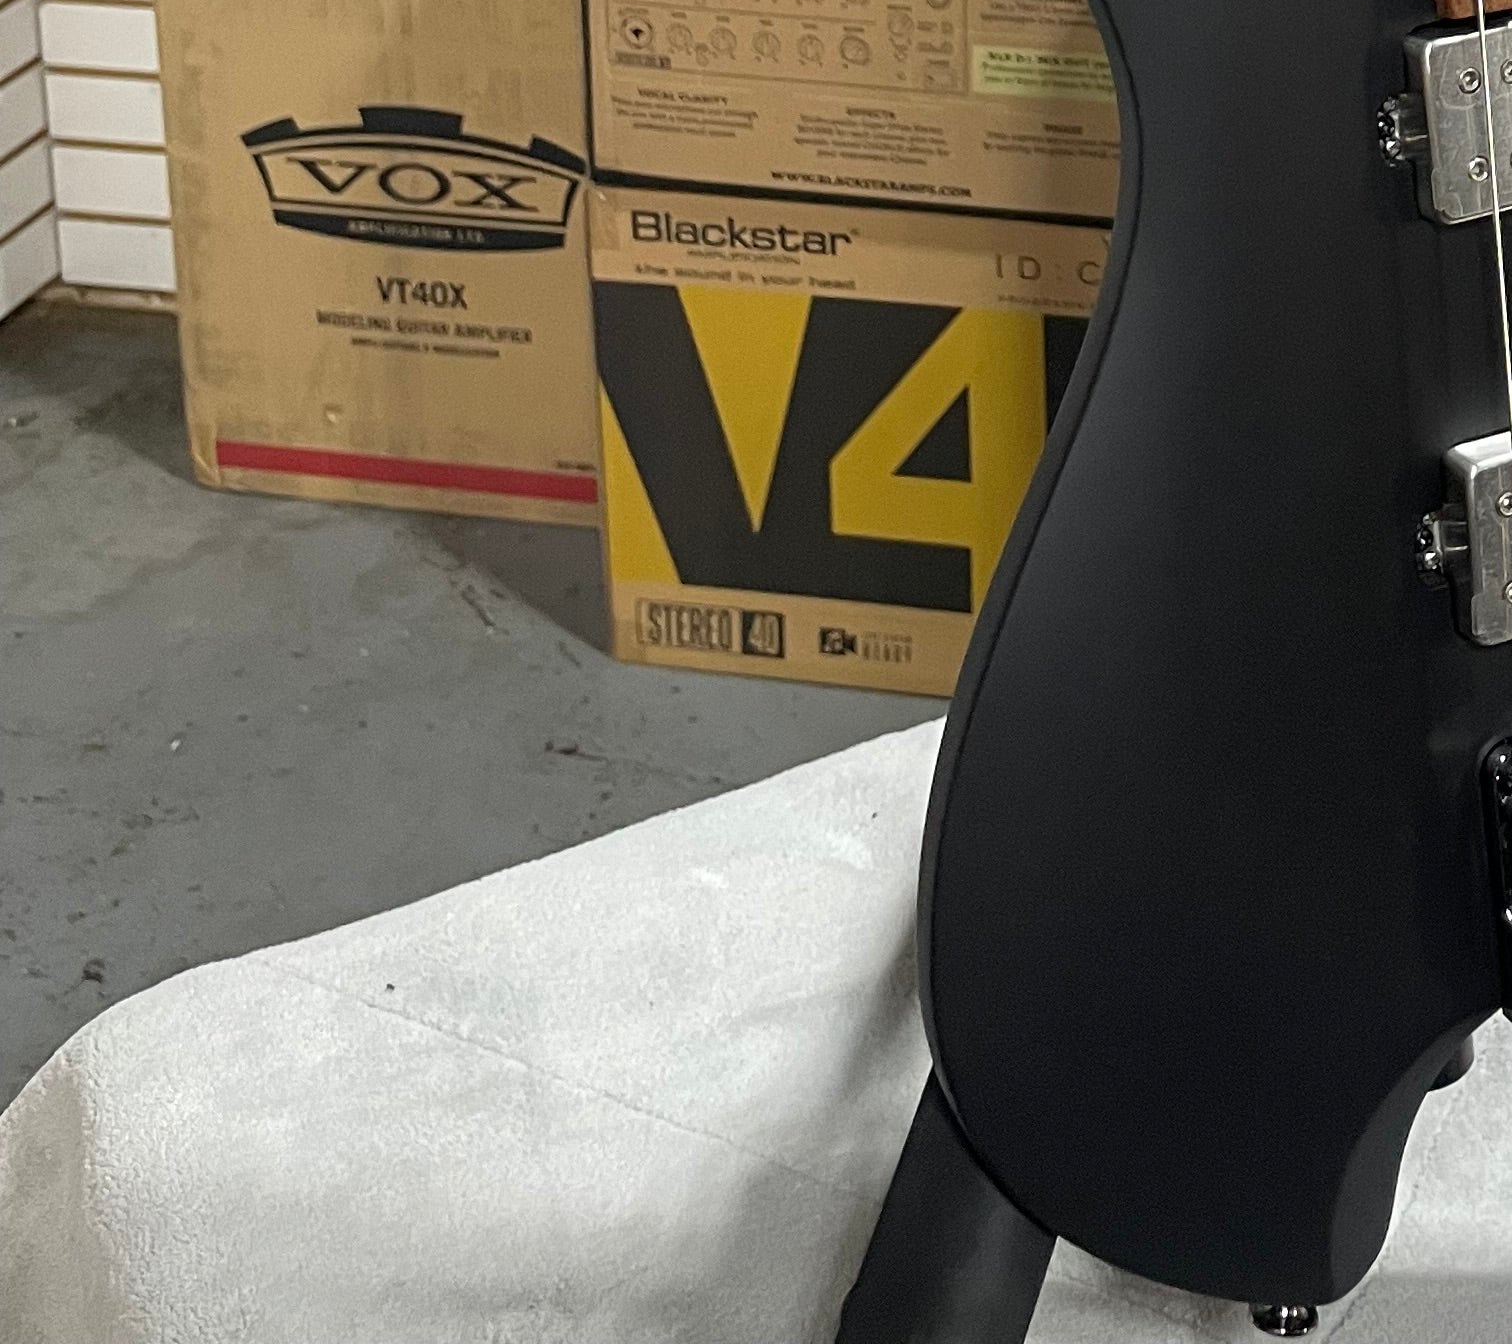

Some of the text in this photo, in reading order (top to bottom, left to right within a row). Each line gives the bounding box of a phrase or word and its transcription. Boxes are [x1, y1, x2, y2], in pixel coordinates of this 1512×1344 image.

[286, 155, 539, 213] VOX
[630, 209, 853, 256] Blackstar
[376, 274, 468, 311] VT40X
[633, 262, 857, 291] the sound in your head
[649, 601, 781, 654] STEREO 40
